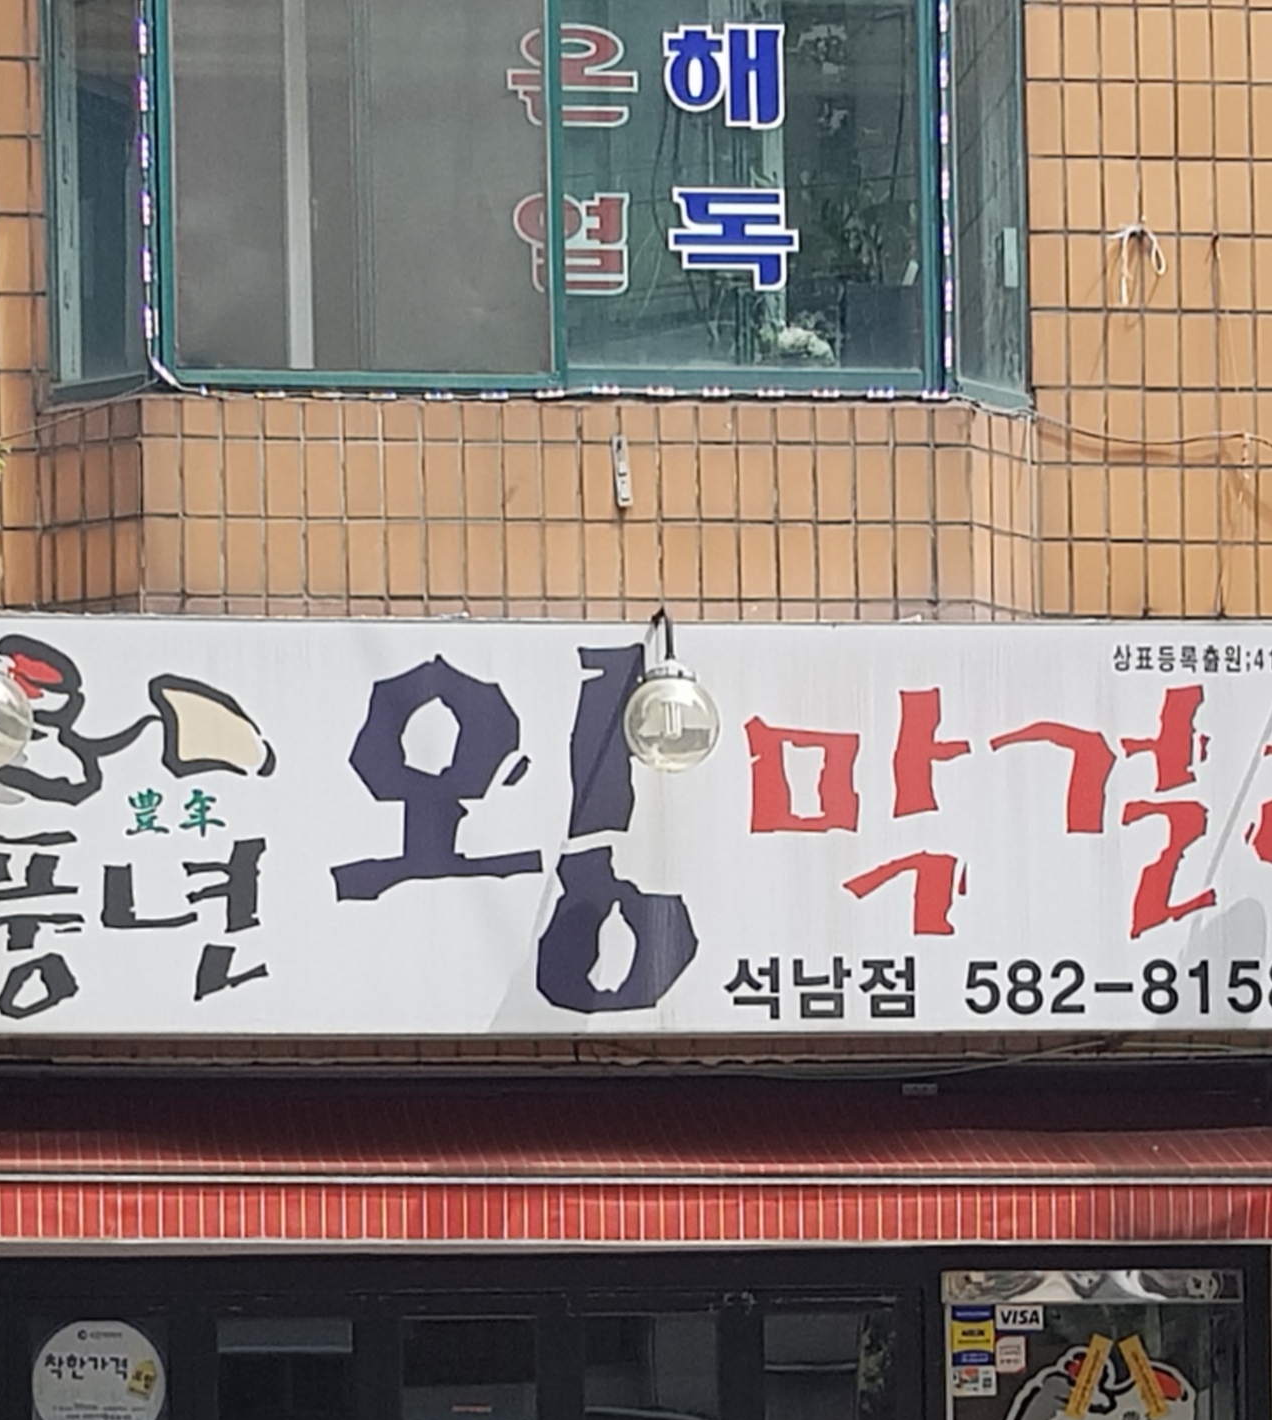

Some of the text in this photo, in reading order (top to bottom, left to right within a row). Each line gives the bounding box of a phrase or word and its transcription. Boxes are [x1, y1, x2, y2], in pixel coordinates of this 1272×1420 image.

[663, 22, 799, 291] 해독
[725, 955, 916, 1020] 석남점
[1001, 1309, 1040, 1325] VISA
[45, 1353, 129, 1382] 착한가격
